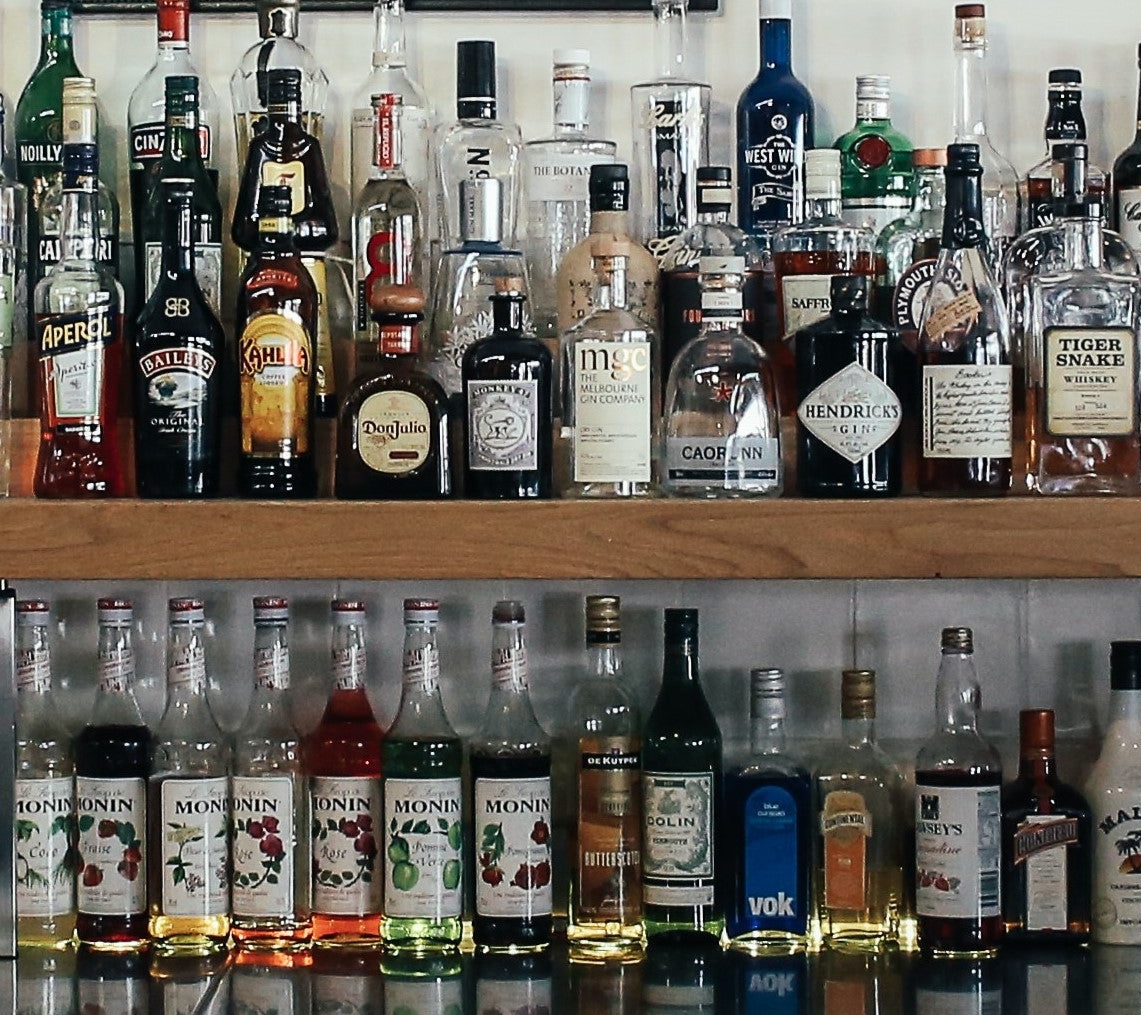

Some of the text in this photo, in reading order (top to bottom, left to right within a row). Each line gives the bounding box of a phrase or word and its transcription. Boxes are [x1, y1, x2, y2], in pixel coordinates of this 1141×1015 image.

[20, 144, 62, 162] NOILLY
[744, 149, 774, 164] WEST
[791, 298, 831, 309] SAFFR
[42, 318, 113, 351] APEROL
[1059, 338, 1122, 352] TIGER
[239, 338, 309, 375] KAHLA
[580, 347, 647, 381] mgc
[1055, 353, 1125, 367] SNAKE
[580, 373, 598, 382] THE
[1063, 375, 1118, 384] WHISKEY
[748, 891, 795, 917] vok
